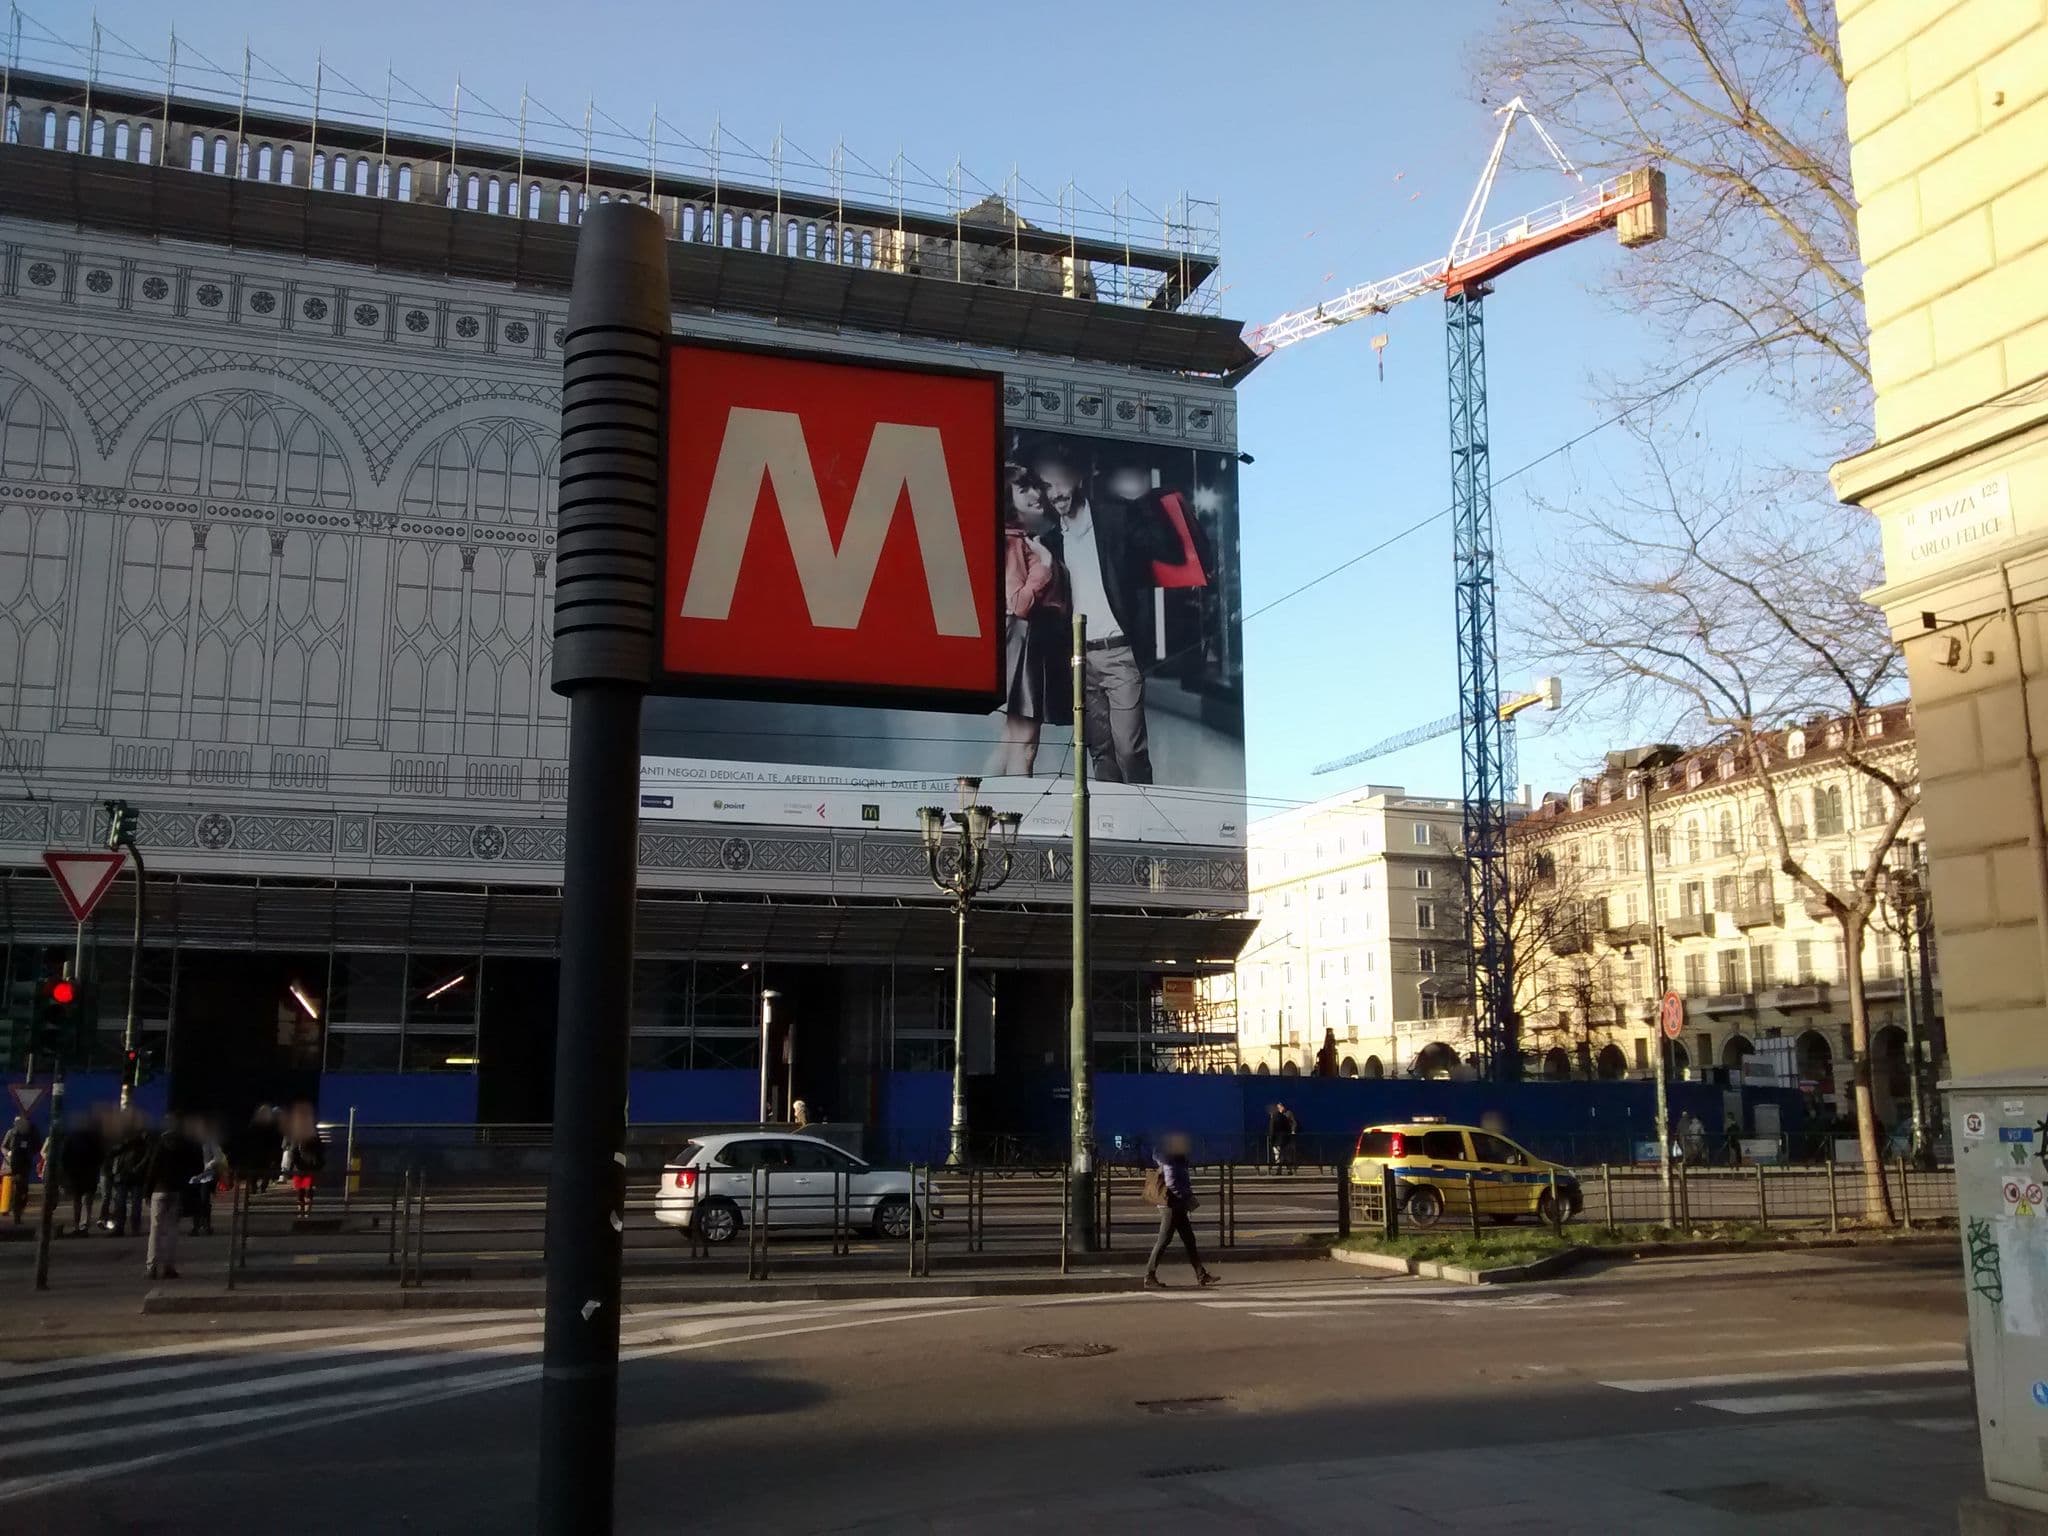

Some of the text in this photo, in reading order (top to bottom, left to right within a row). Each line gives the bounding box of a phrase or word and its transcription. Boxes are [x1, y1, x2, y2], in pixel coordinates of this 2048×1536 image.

[680, 406, 981, 638] M
[1911, 535, 1951, 561] CARLO
[640, 766, 664, 777] ANTI
[667, 767, 707, 779] NEGOZI
[710, 769, 754, 781] DEDICATI
[757, 772, 765, 782] A
[784, 774, 815, 785] APERTI
[818, 777, 842, 785] TUTTI
[891, 780, 918, 791] DALLE
[929, 782, 950, 792] ALLE
